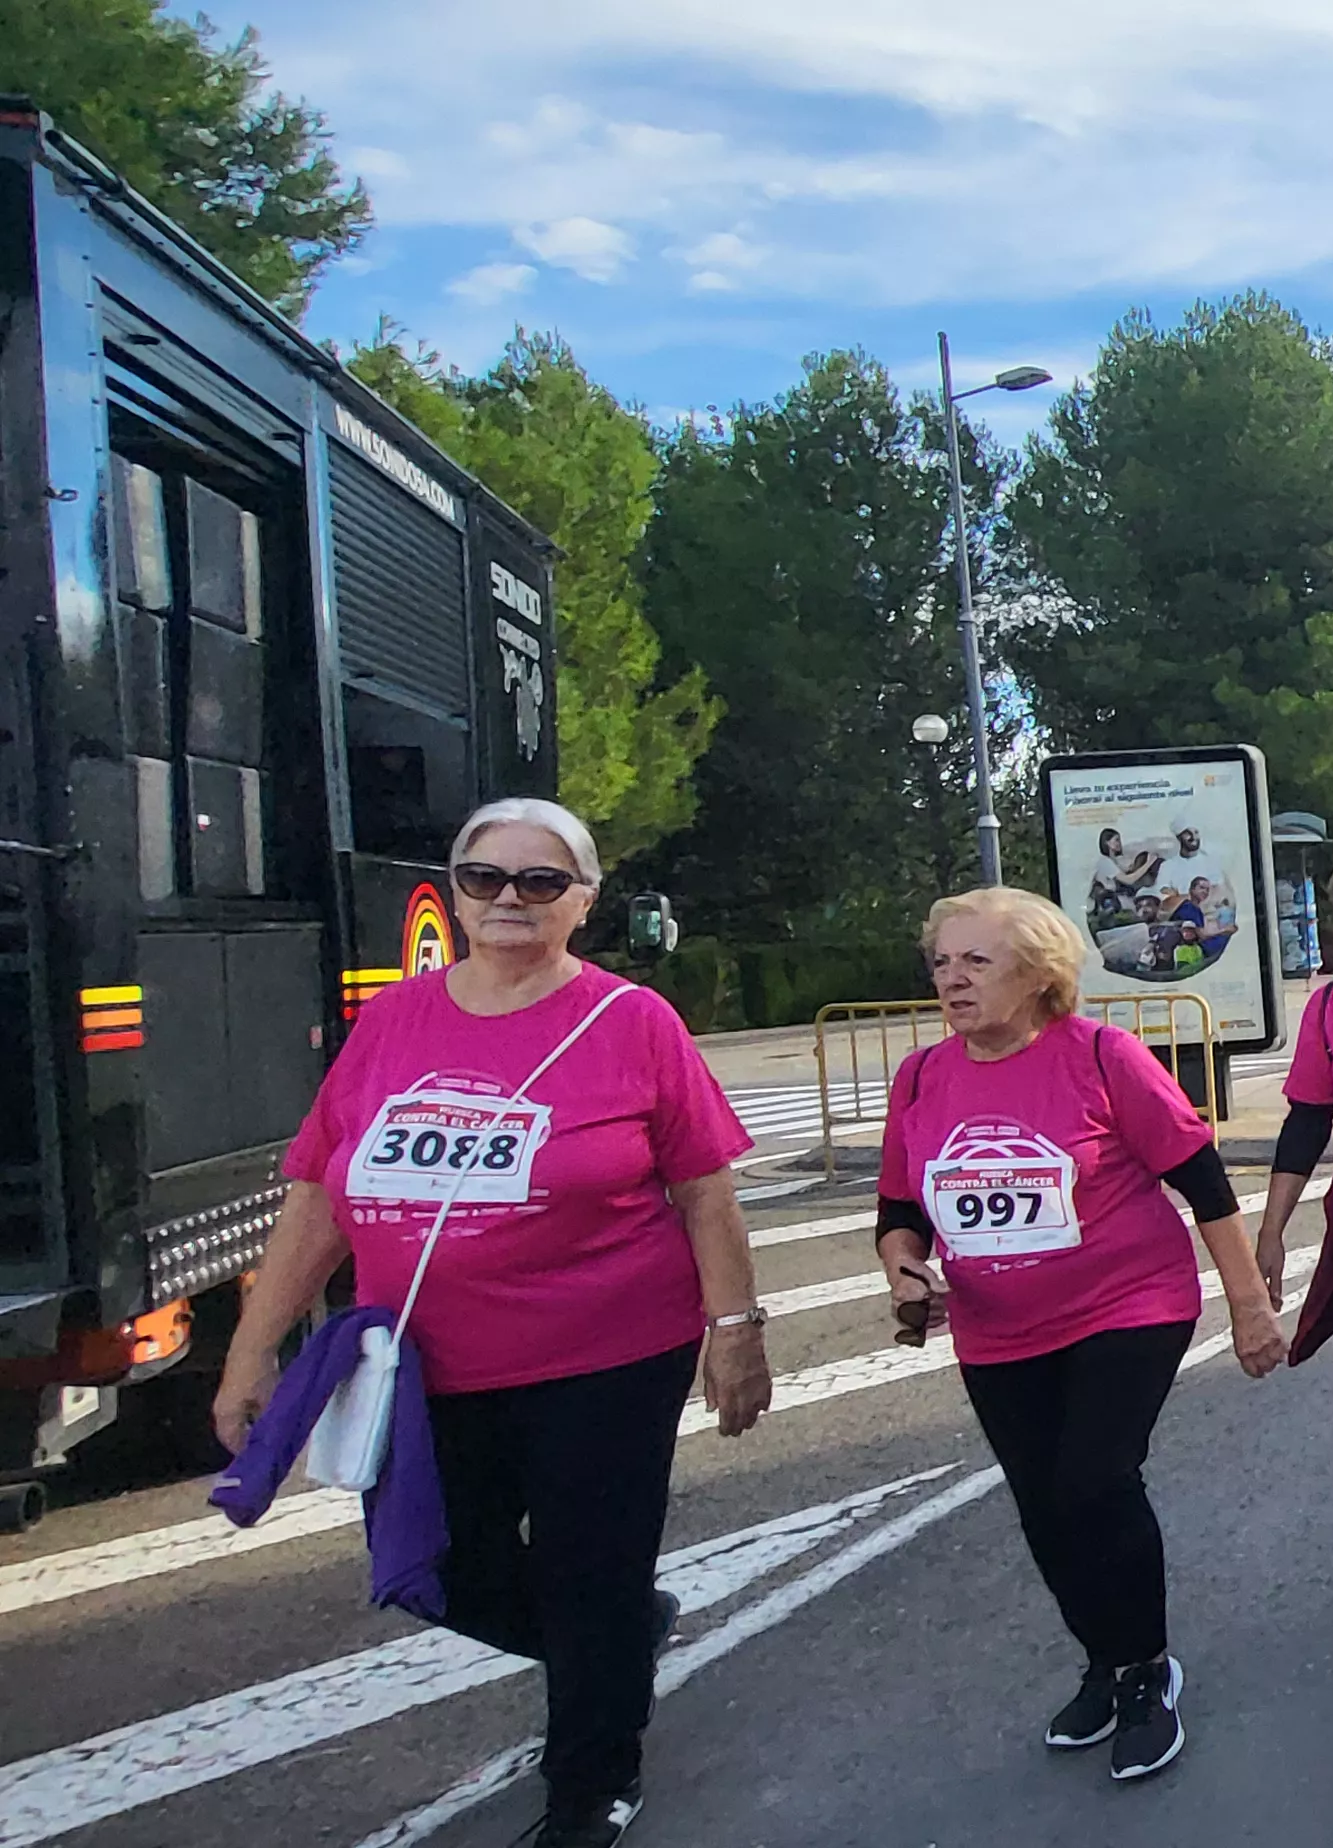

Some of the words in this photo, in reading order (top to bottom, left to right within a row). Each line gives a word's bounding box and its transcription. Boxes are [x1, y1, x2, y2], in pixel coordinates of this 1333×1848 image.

[394, 1113, 447, 1126] CONTRA
[451, 1117, 466, 1129] EL
[371, 1128, 519, 1171] 3088
[941, 1179, 988, 1189] CONTRA
[991, 1178, 1005, 1188] EL
[1007, 1176, 1055, 1188] CÁNCER
[956, 1192, 1042, 1229] 997
